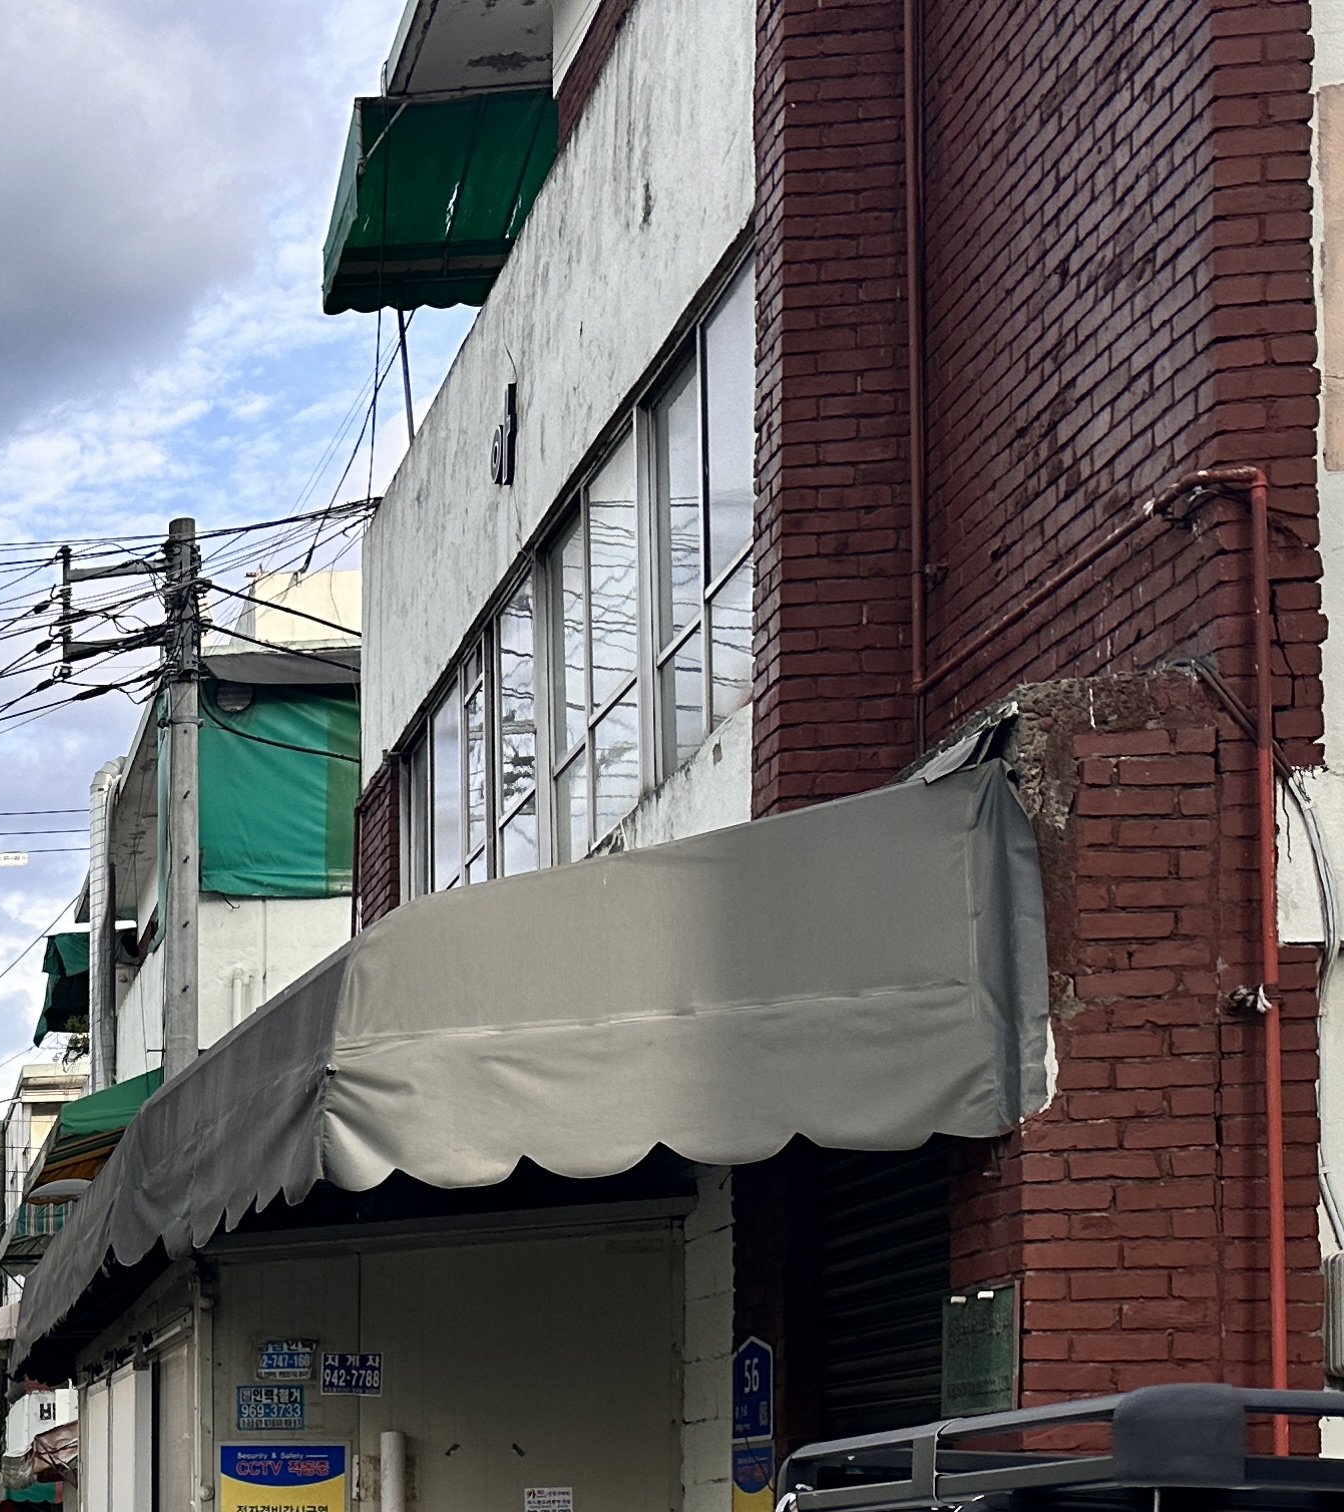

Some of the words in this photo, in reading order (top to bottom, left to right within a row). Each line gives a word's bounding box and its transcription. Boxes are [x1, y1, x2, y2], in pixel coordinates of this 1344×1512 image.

[744, 1357, 759, 1394] 56
[241, 1404, 301, 1417] 969-3733
[236, 1461, 283, 1476] CCTV
[288, 1461, 330, 1476] 작동중
